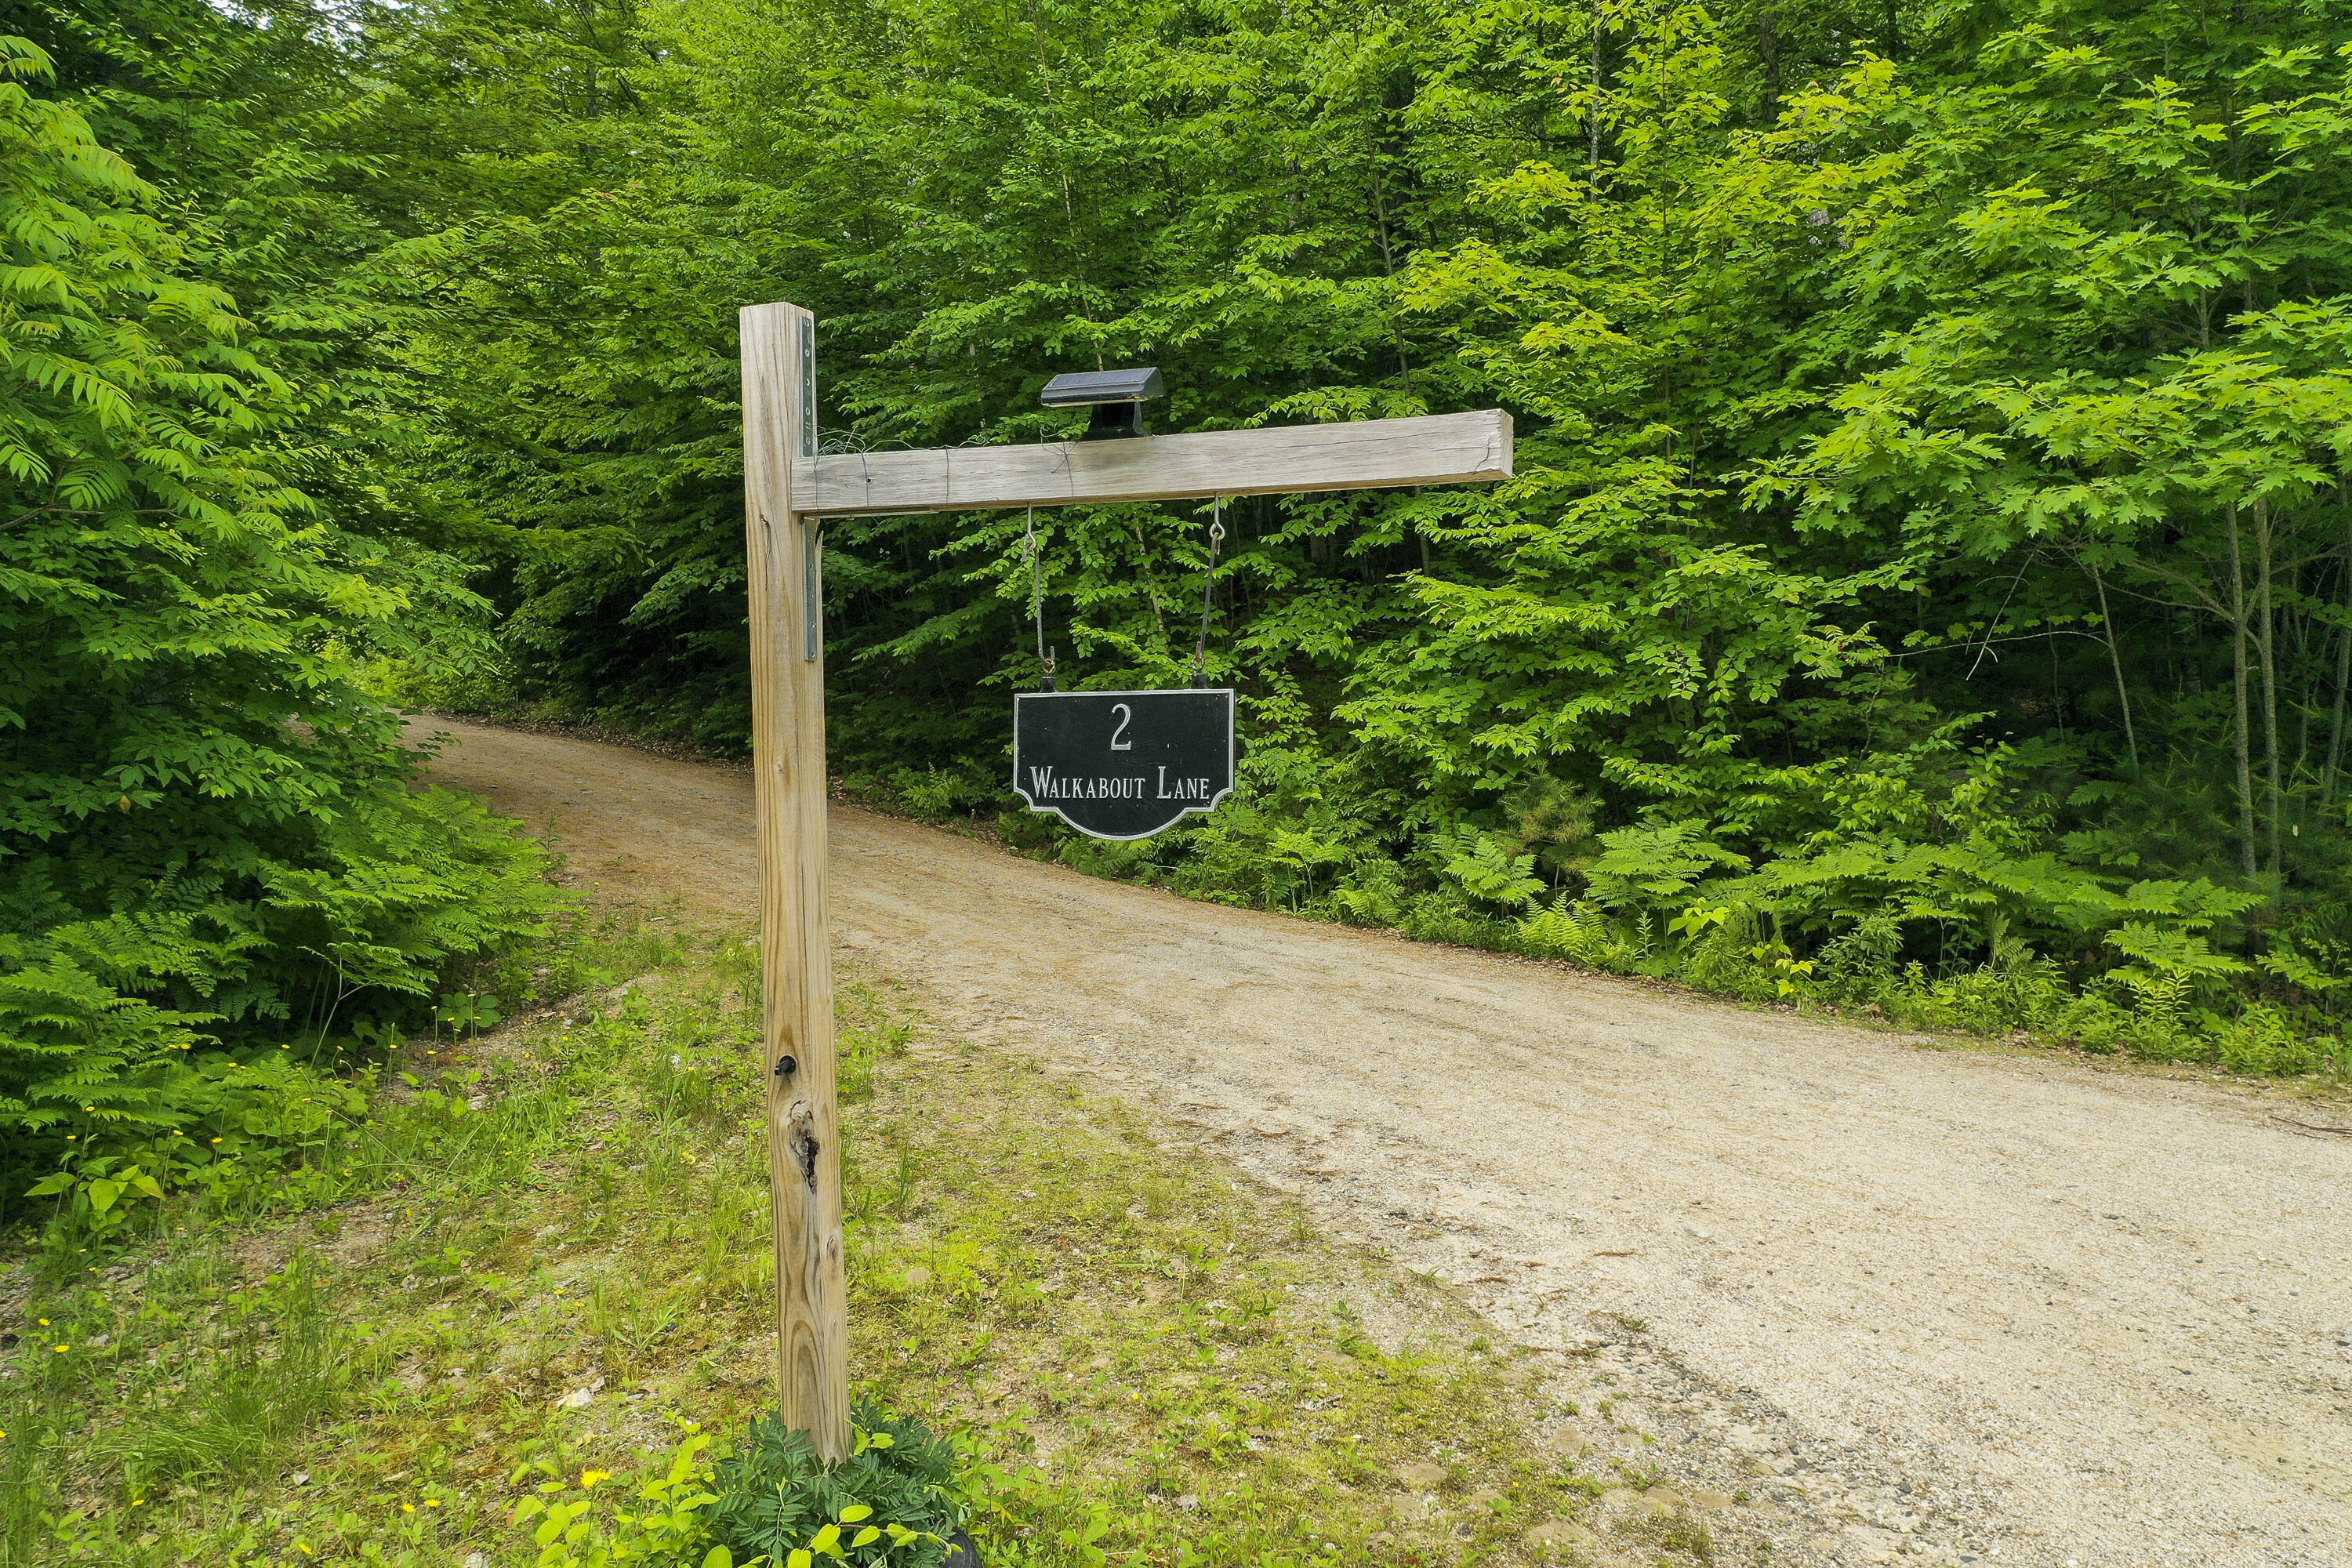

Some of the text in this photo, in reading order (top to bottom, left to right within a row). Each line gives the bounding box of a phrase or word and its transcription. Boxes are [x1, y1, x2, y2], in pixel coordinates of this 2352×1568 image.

[1110, 702, 1131, 751] 2
[1029, 765, 1210, 800] WALKABOUT LANE
